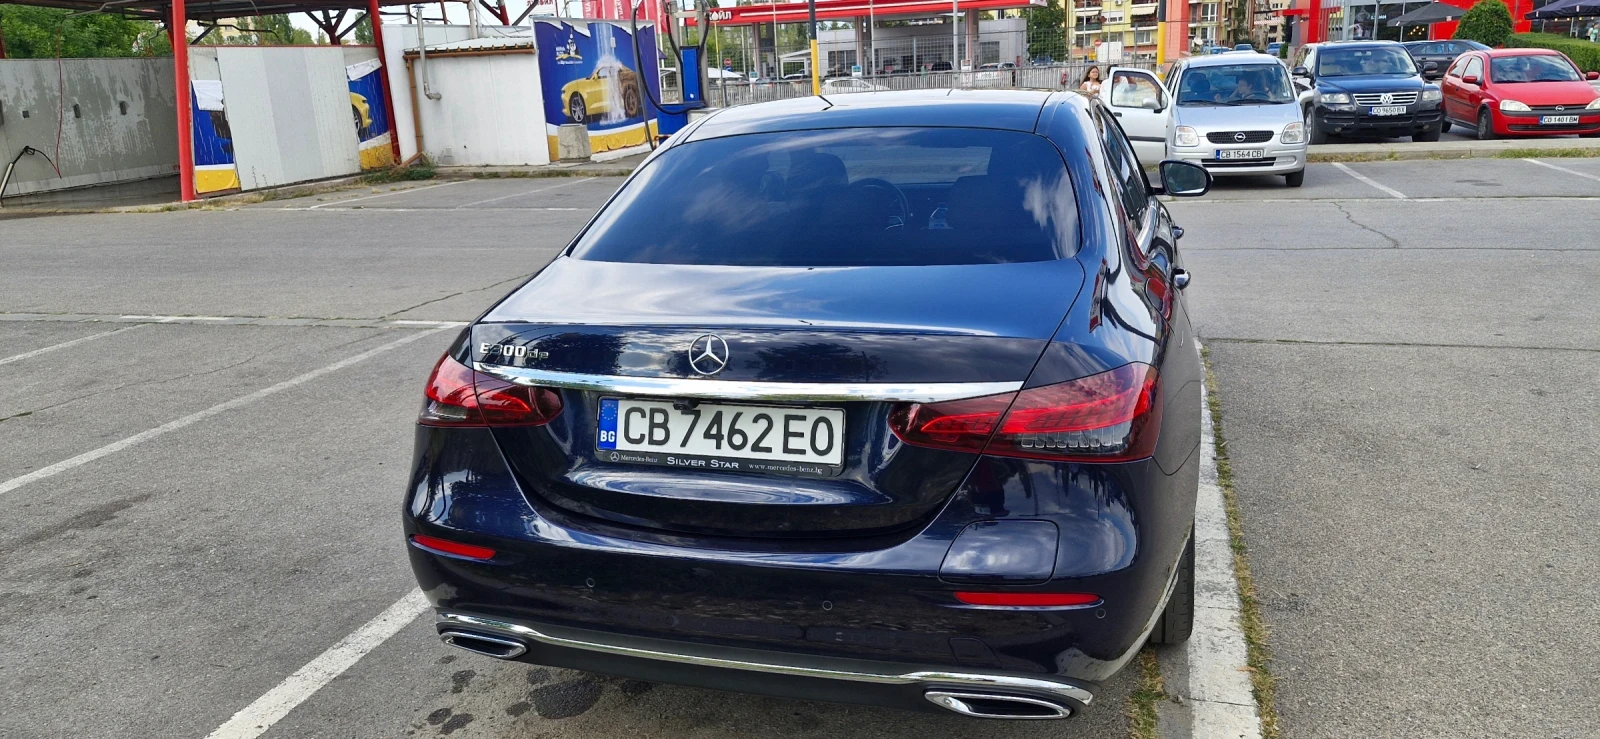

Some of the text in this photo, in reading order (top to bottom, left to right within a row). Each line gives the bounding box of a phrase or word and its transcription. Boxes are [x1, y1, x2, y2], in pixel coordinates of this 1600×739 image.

[1233, 150, 1251, 158] 1564
[1251, 150, 1262, 158] CB
[600, 430, 615, 442] BG
[624, 406, 670, 446] CB
[680, 409, 773, 453] 7462
[621, 454, 658, 463] Mercedes-Benz
[748, 463, 823, 475] www.mercedes-benz.bg
